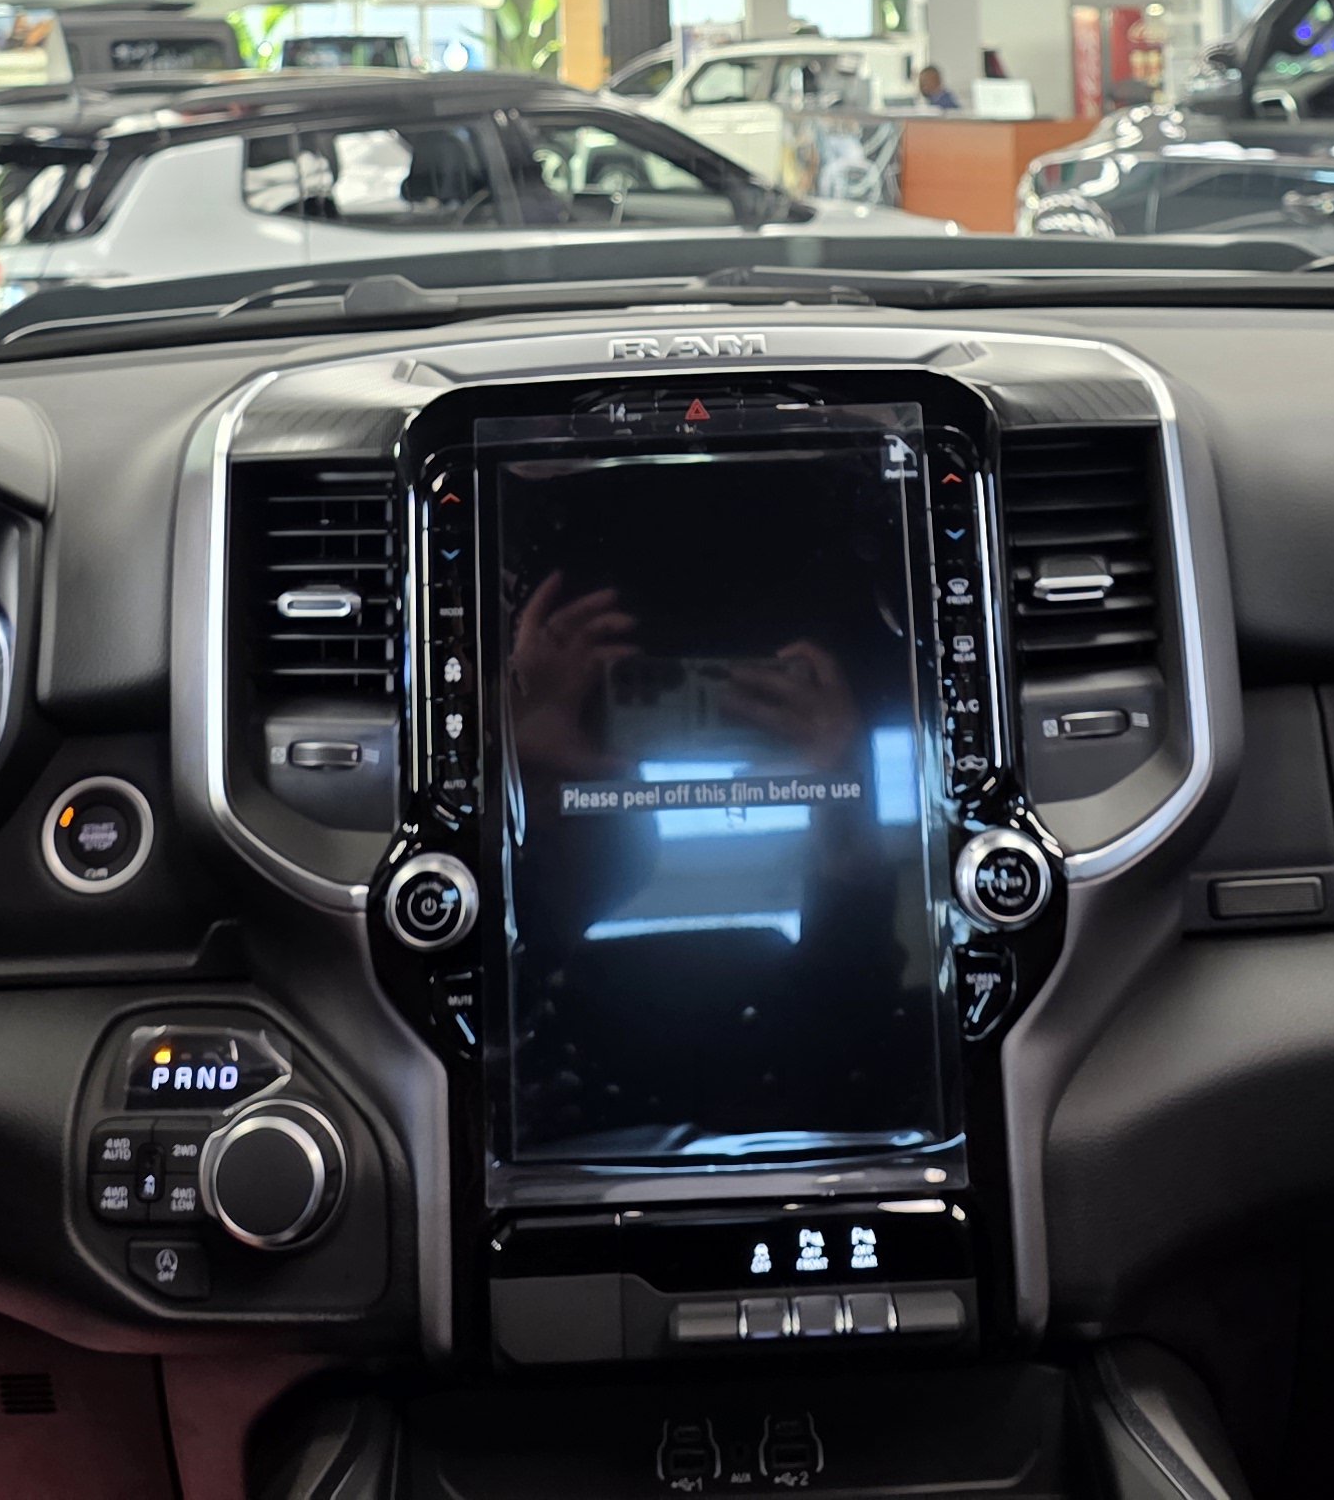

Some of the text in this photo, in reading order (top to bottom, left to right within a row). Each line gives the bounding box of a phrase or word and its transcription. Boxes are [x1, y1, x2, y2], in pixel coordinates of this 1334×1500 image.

[607, 333, 767, 360] RAM
[562, 779, 861, 810] Please peel off this film before use
[104, 1137, 131, 1149] 4WD
[101, 1149, 132, 1161] AUTO
[171, 1144, 198, 1157] 2WD
